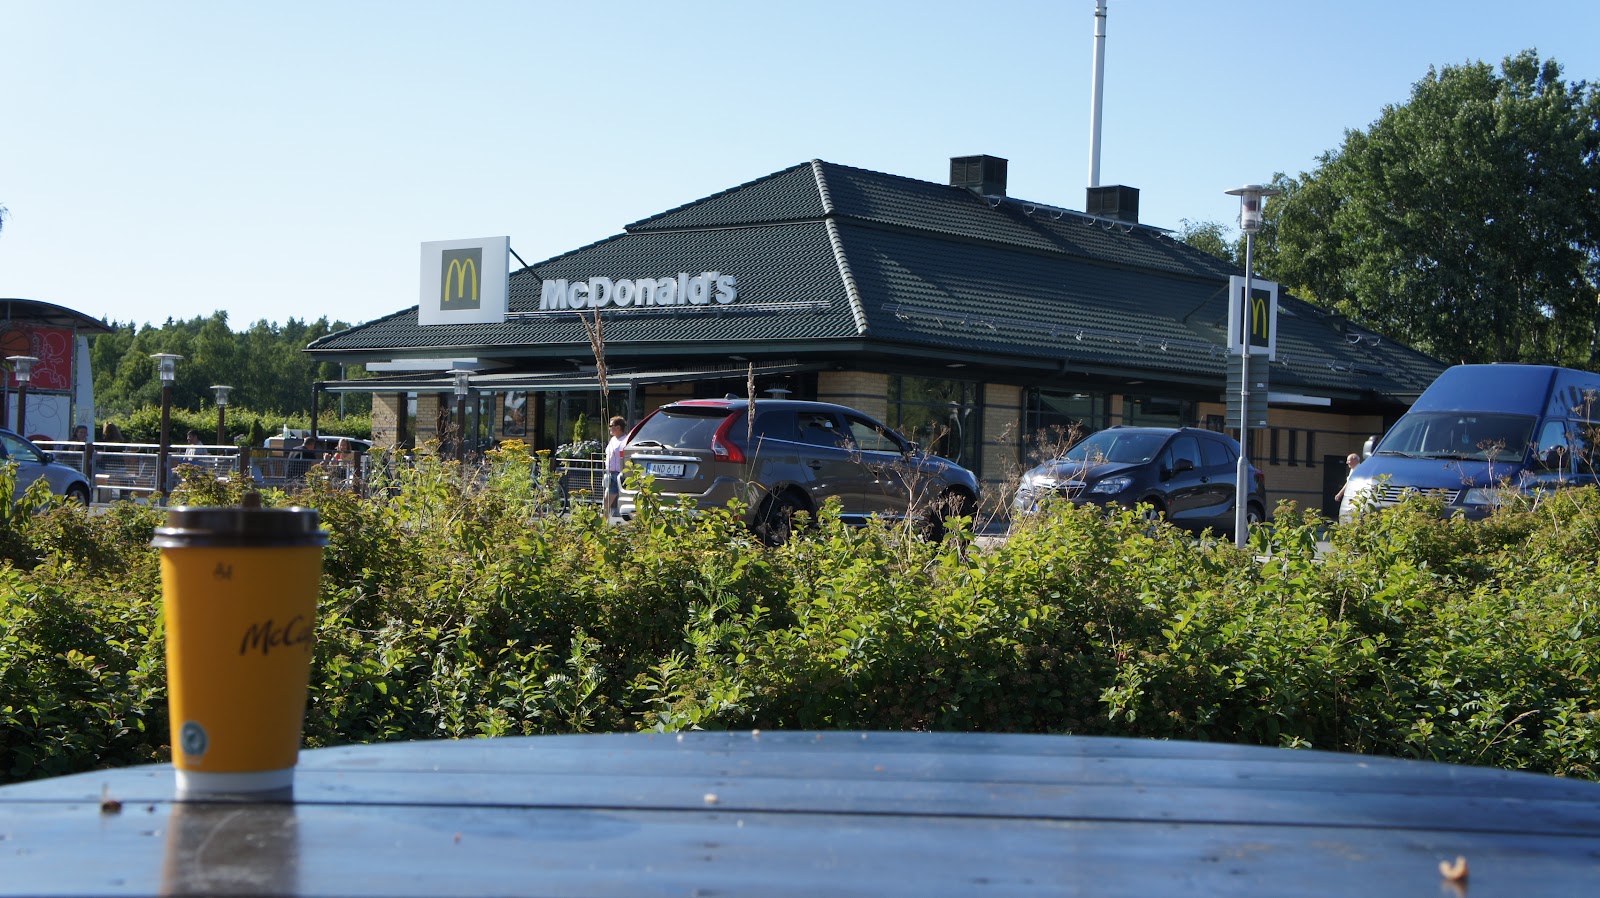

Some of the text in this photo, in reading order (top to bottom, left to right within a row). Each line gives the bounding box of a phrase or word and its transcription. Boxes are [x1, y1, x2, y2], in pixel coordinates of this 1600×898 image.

[445, 258, 477, 302] M
[539, 271, 738, 310] McDonald's
[652, 463, 681, 475] AND 611
[239, 613, 312, 656] McCa
